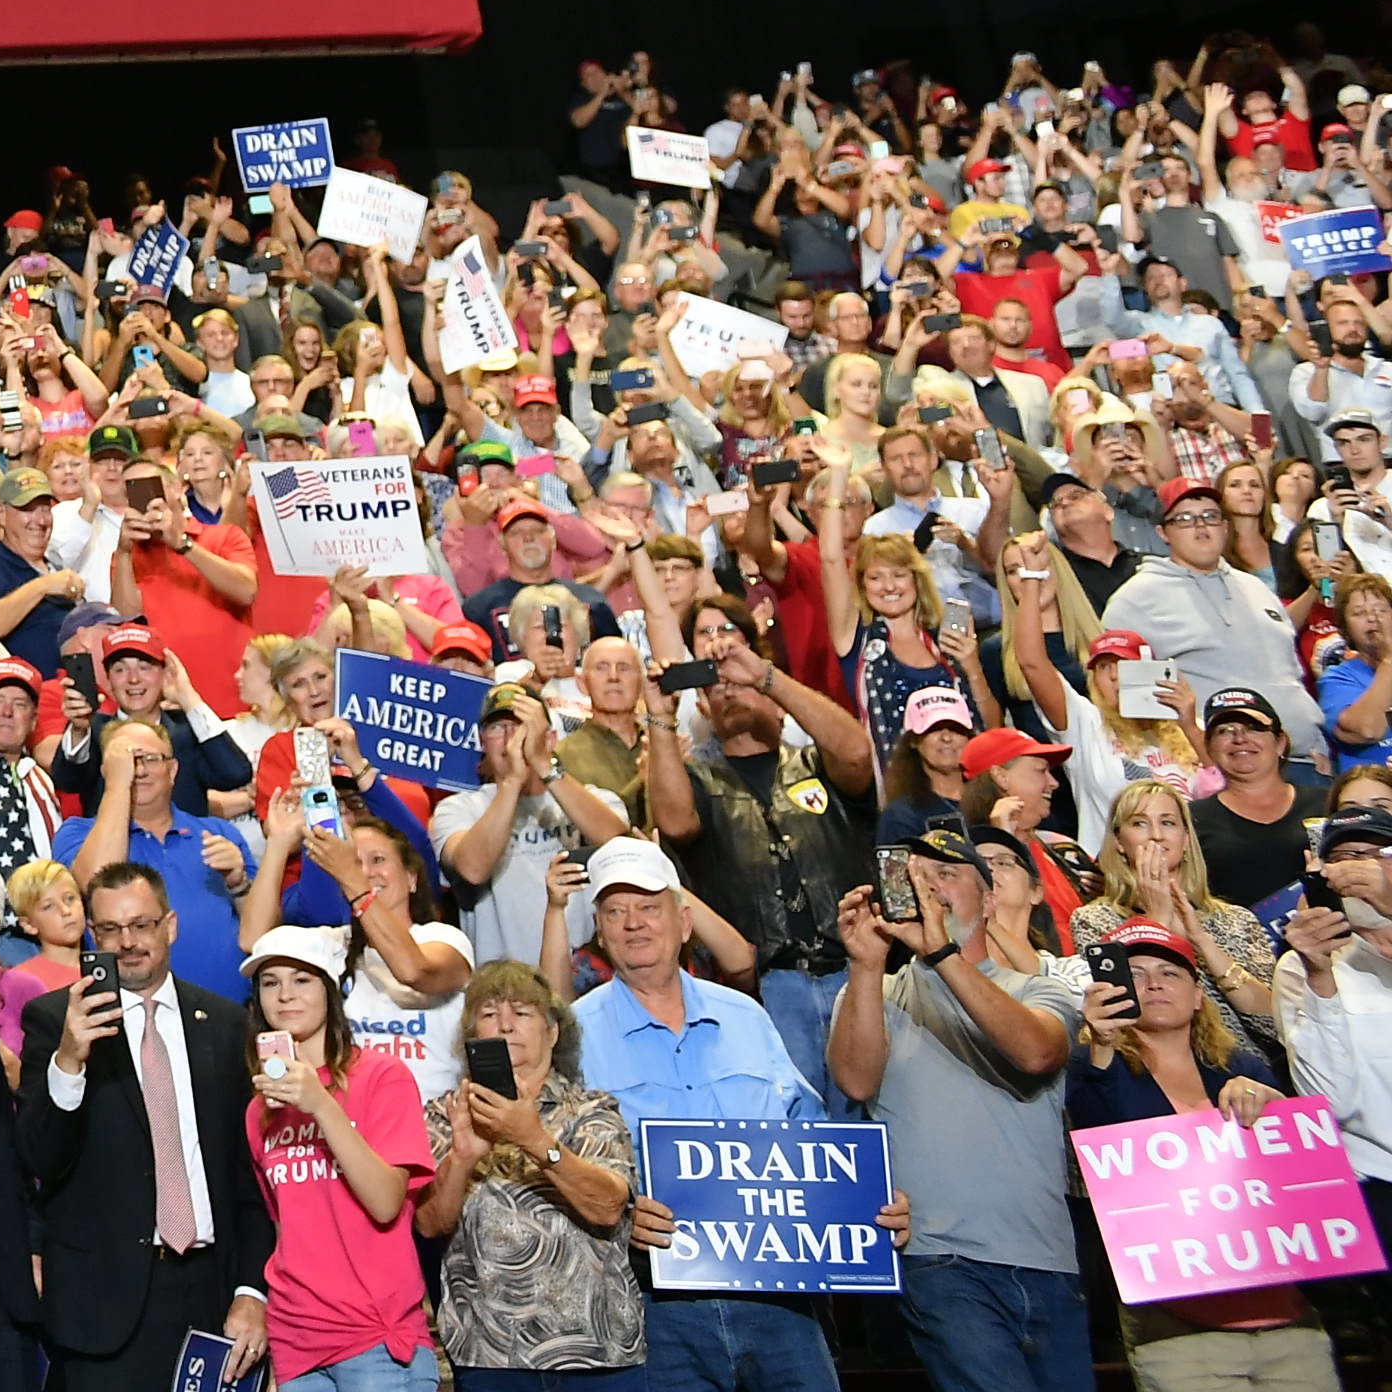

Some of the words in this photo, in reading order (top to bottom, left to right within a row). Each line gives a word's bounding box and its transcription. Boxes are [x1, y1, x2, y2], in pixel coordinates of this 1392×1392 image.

[246, 127, 317, 153] DRAIN
[269, 149, 296, 163] THE
[247, 157, 327, 184] SWAMP
[1290, 227, 1375, 250] TRUMP
[455, 280, 490, 355] TRUMP
[319, 466, 406, 483] VETERANS
[374, 482, 408, 495] FOR
[296, 499, 411, 523] TRUMP
[312, 536, 405, 556] AMERICA
[389, 672, 447, 704] KEEP
[916, 697, 959, 709] TRUMP
[343, 693, 483, 753] AMERICA
[376, 738, 445, 772] GREAT
[287, 1145, 315, 1159] FOR
[1079, 1109, 1338, 1180] WOMEN
[675, 1140, 858, 1184] DRAIN
[738, 1188, 806, 1217] THE
[1179, 1179, 1274, 1215] FOR
[672, 1219, 879, 1264] SWAMP
[1124, 1217, 1360, 1283] TRUMP
